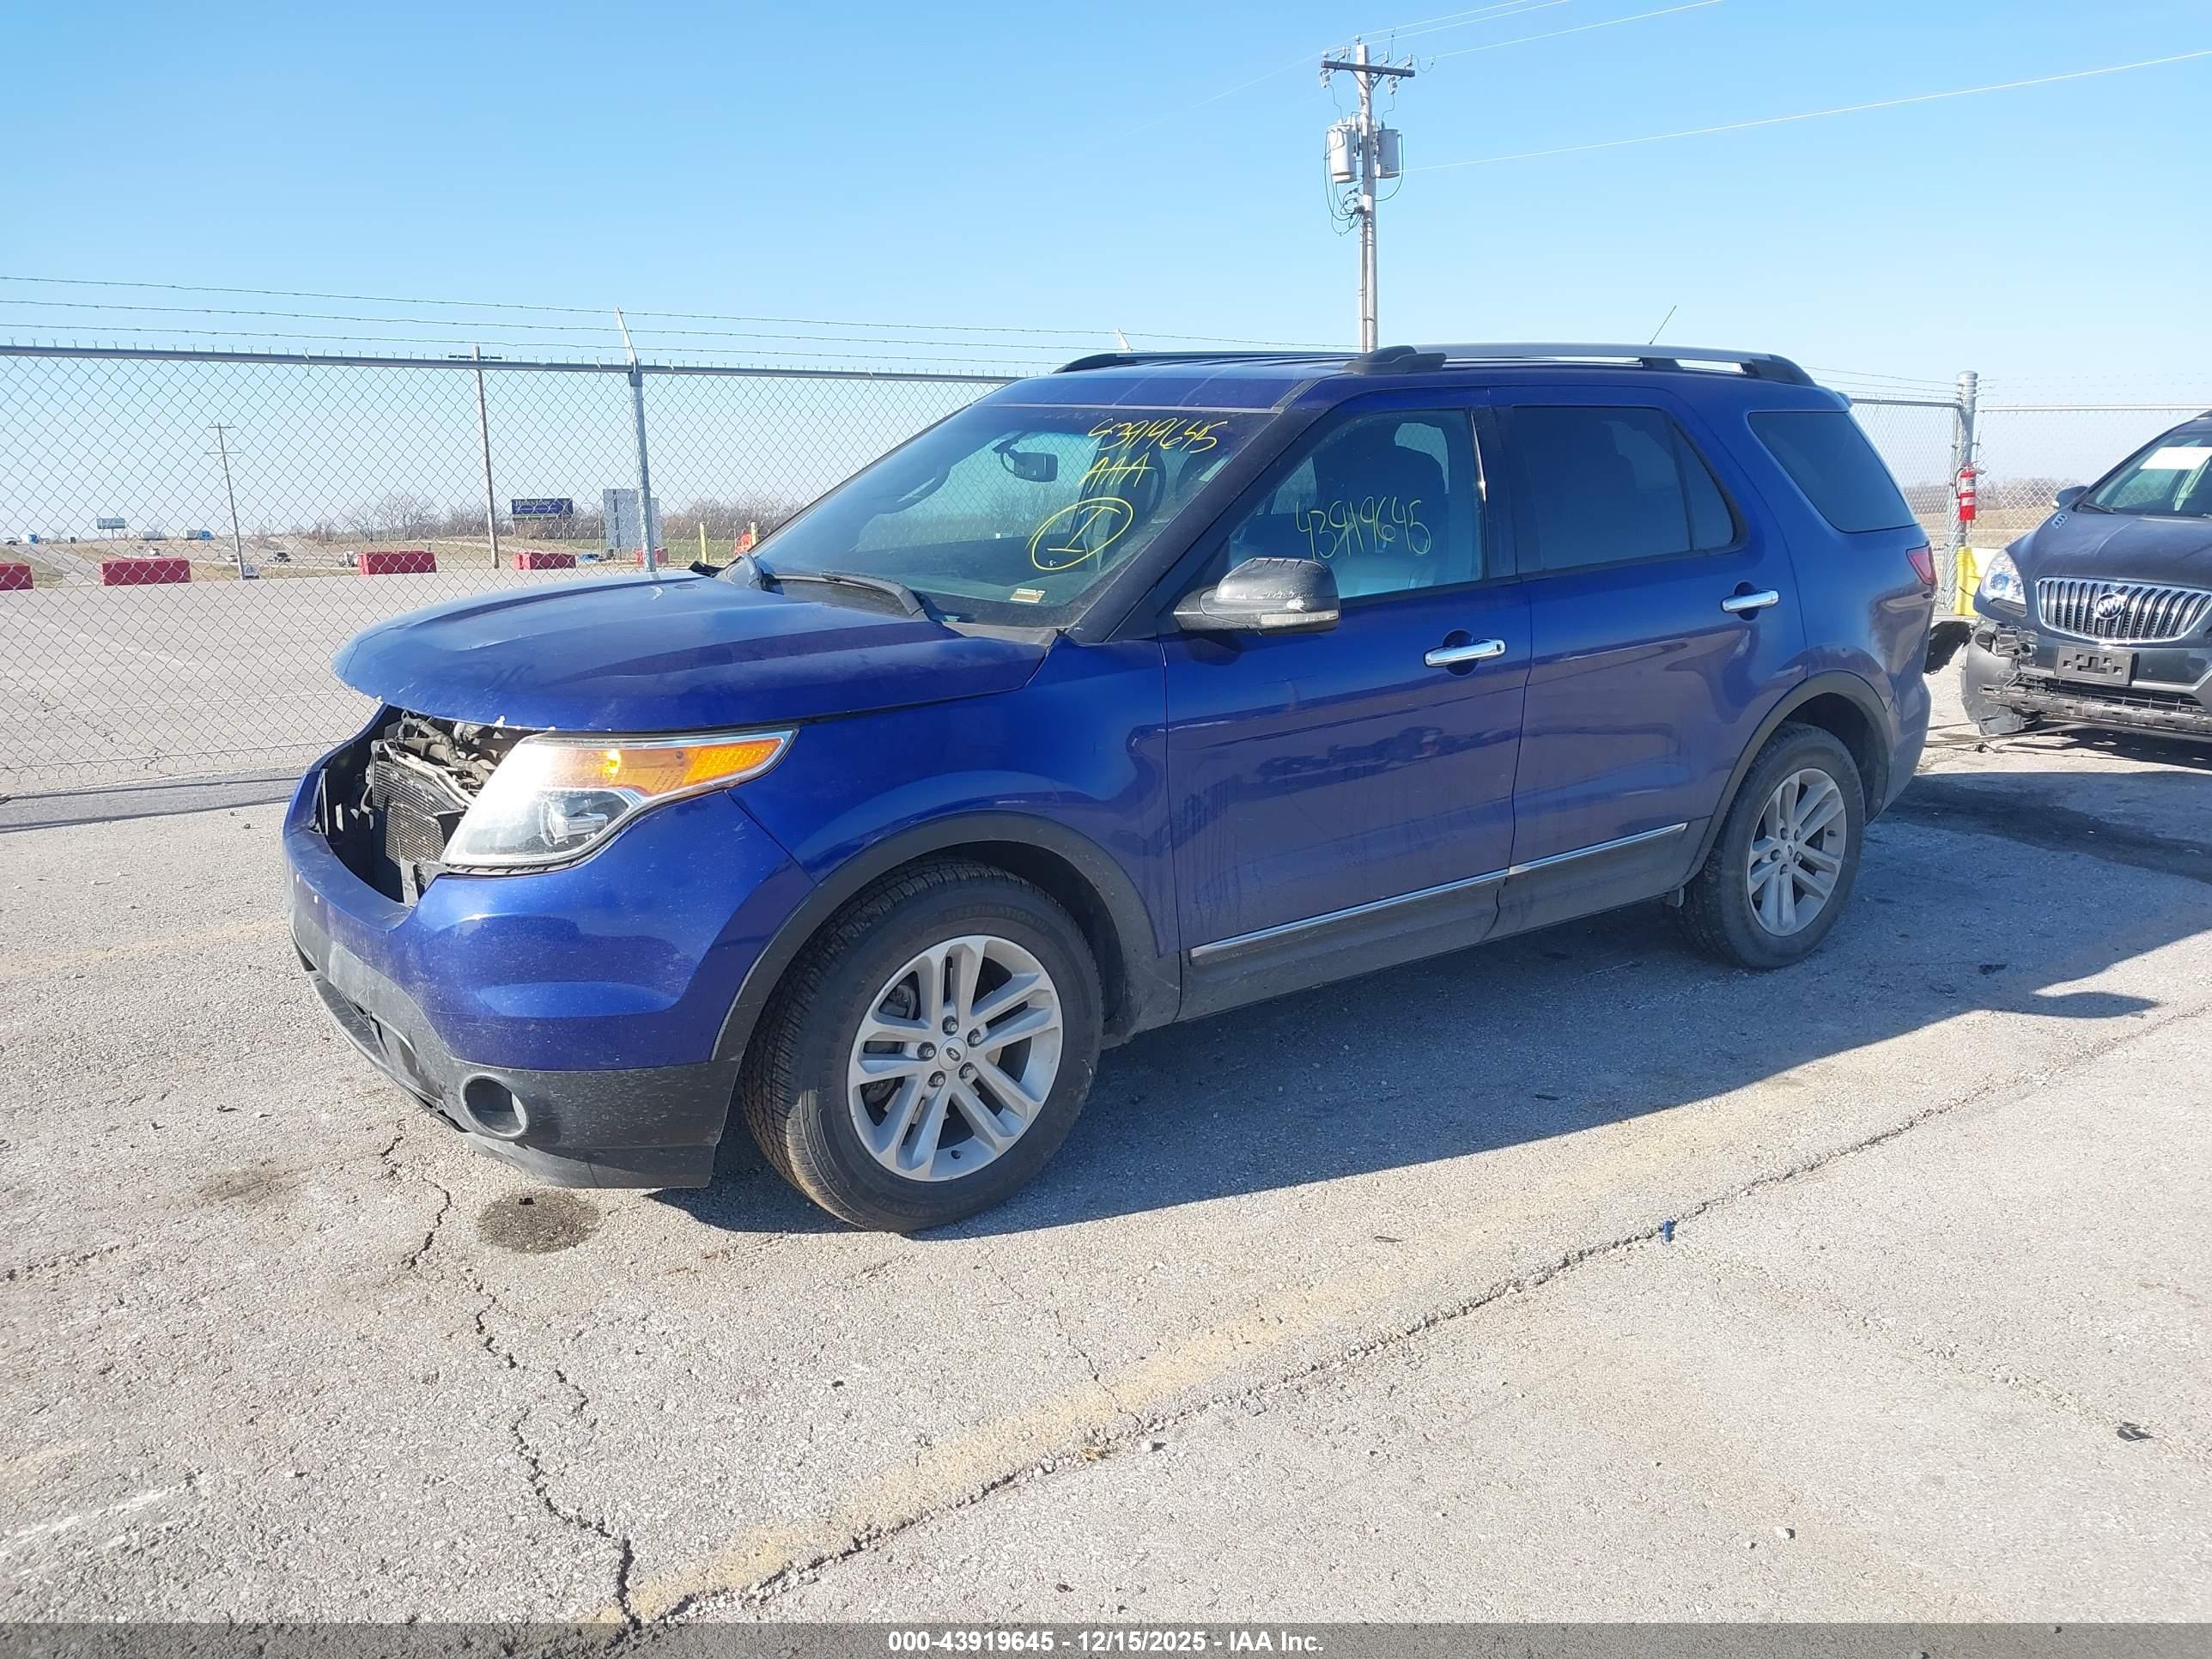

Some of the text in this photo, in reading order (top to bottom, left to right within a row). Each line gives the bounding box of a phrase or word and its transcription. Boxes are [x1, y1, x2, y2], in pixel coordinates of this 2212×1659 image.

[1085, 417, 1229, 454] 43919645
[1079, 452, 1157, 495] AAA
[1296, 495, 1432, 560] 43919645
